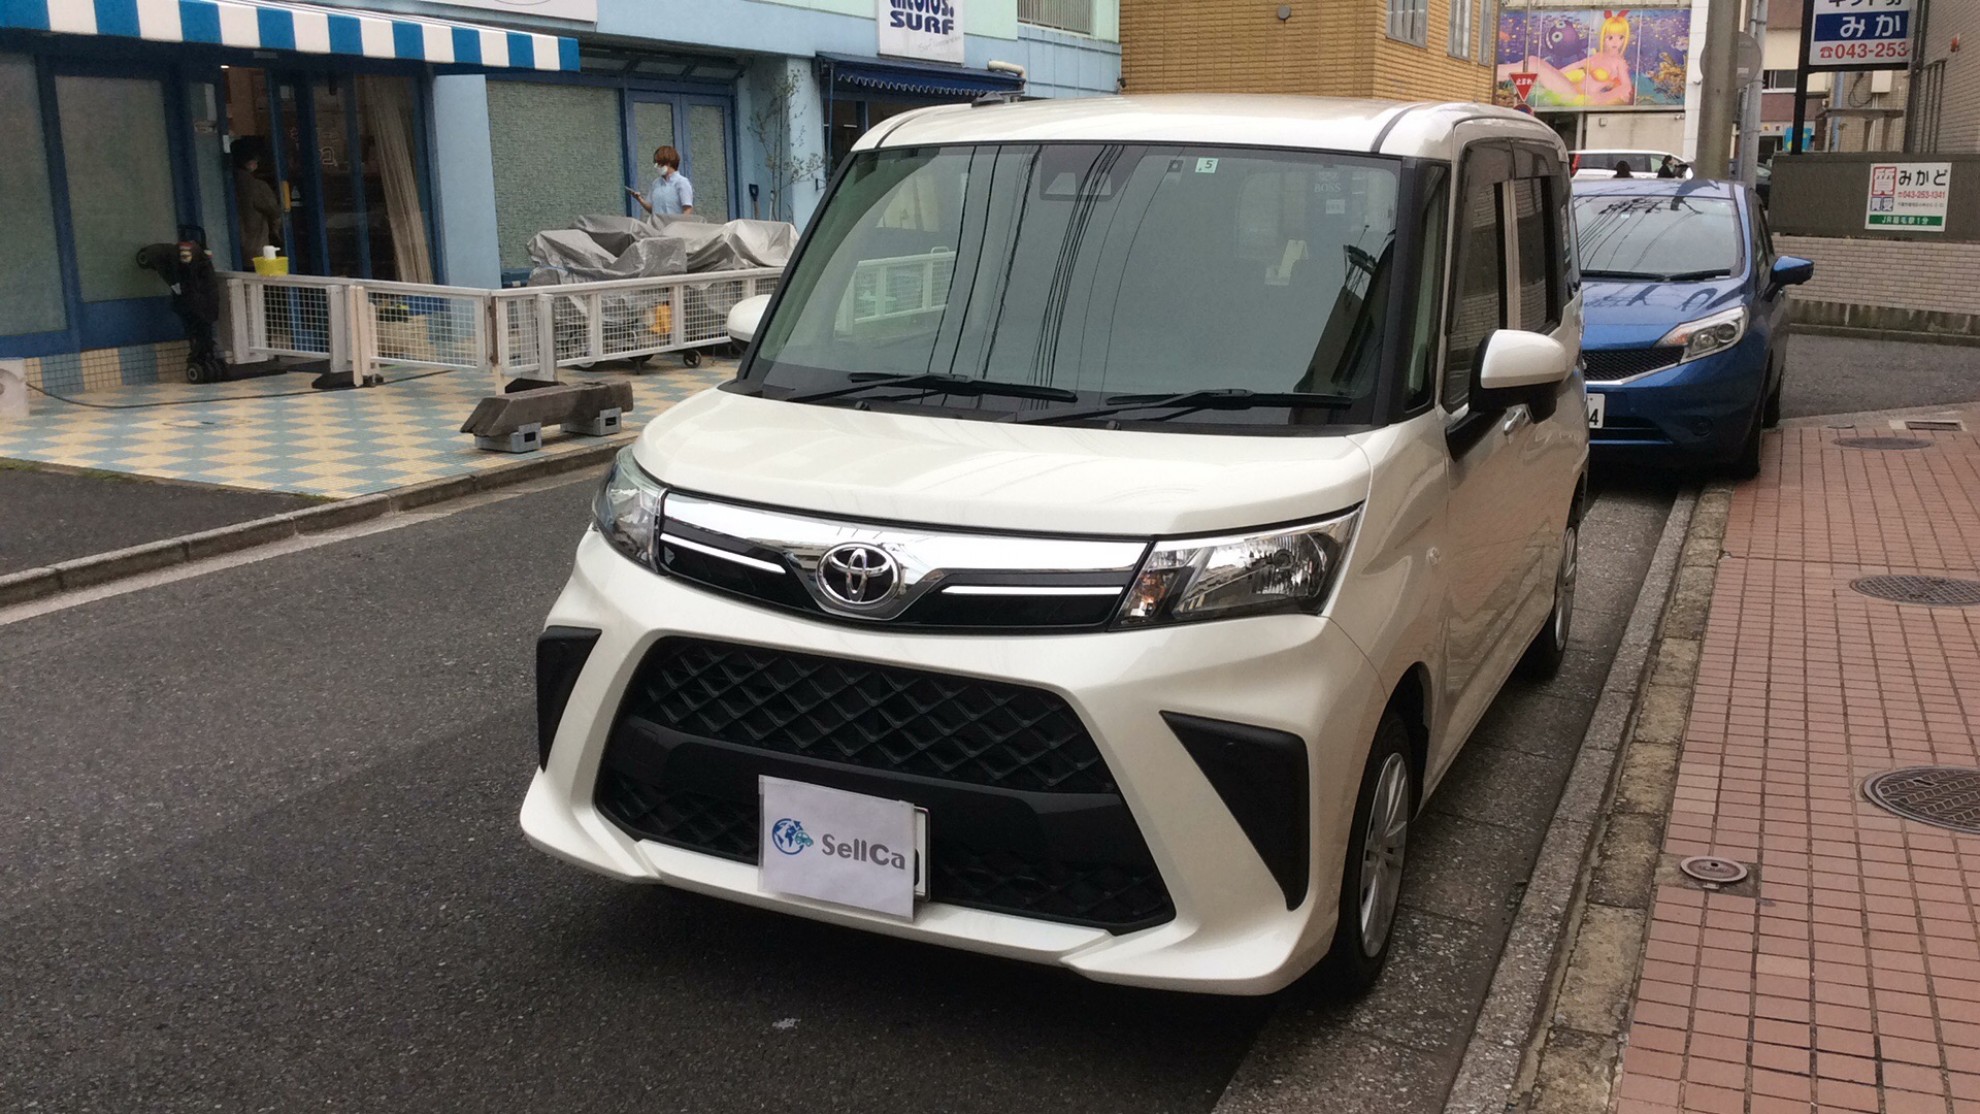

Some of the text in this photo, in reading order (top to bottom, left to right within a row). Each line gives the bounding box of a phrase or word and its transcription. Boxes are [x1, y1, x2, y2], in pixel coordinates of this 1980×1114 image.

[890, 10, 954, 35] SURF
[1205, 160, 1213, 169] 5
[1898, 169, 1948, 186] みかど
[1589, 408, 1599, 426] 4
[822, 833, 906, 870] SellCa
